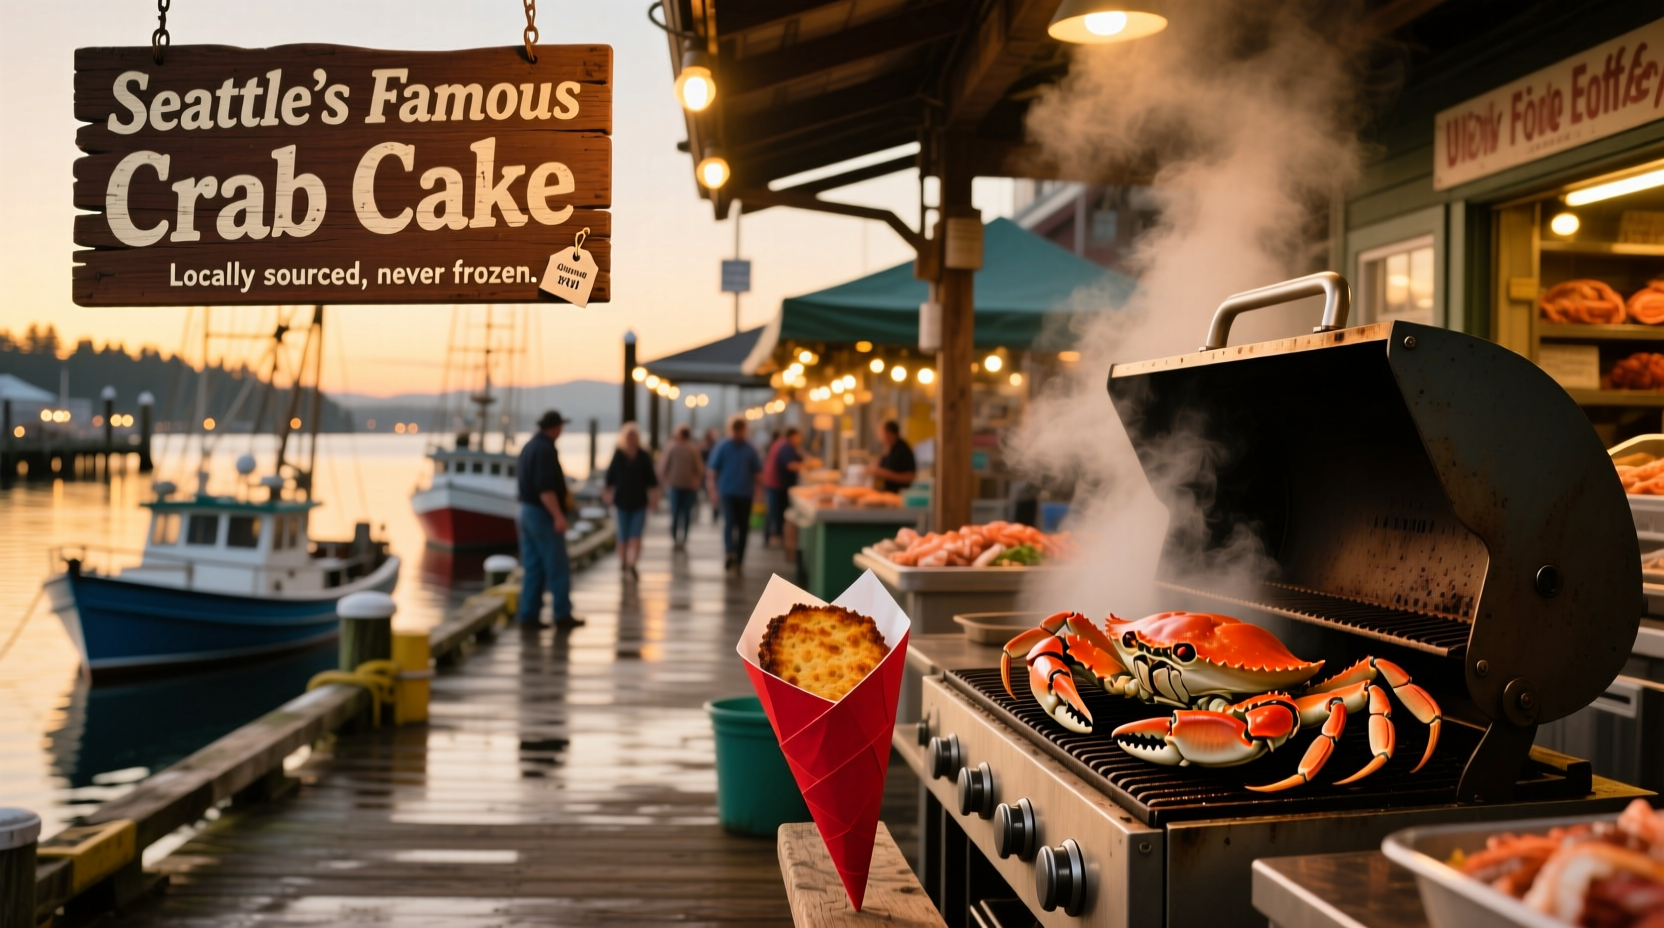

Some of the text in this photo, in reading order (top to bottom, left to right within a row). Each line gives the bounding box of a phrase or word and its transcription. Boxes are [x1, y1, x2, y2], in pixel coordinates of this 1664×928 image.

[107, 68, 581, 135] Seattle's Famous
[105, 136, 577, 247] Crab Cake
[170, 261, 256, 293] Locally
[263, 260, 368, 290] sourced,
[377, 267, 446, 285] never
[452, 259, 538, 285] frozen.
